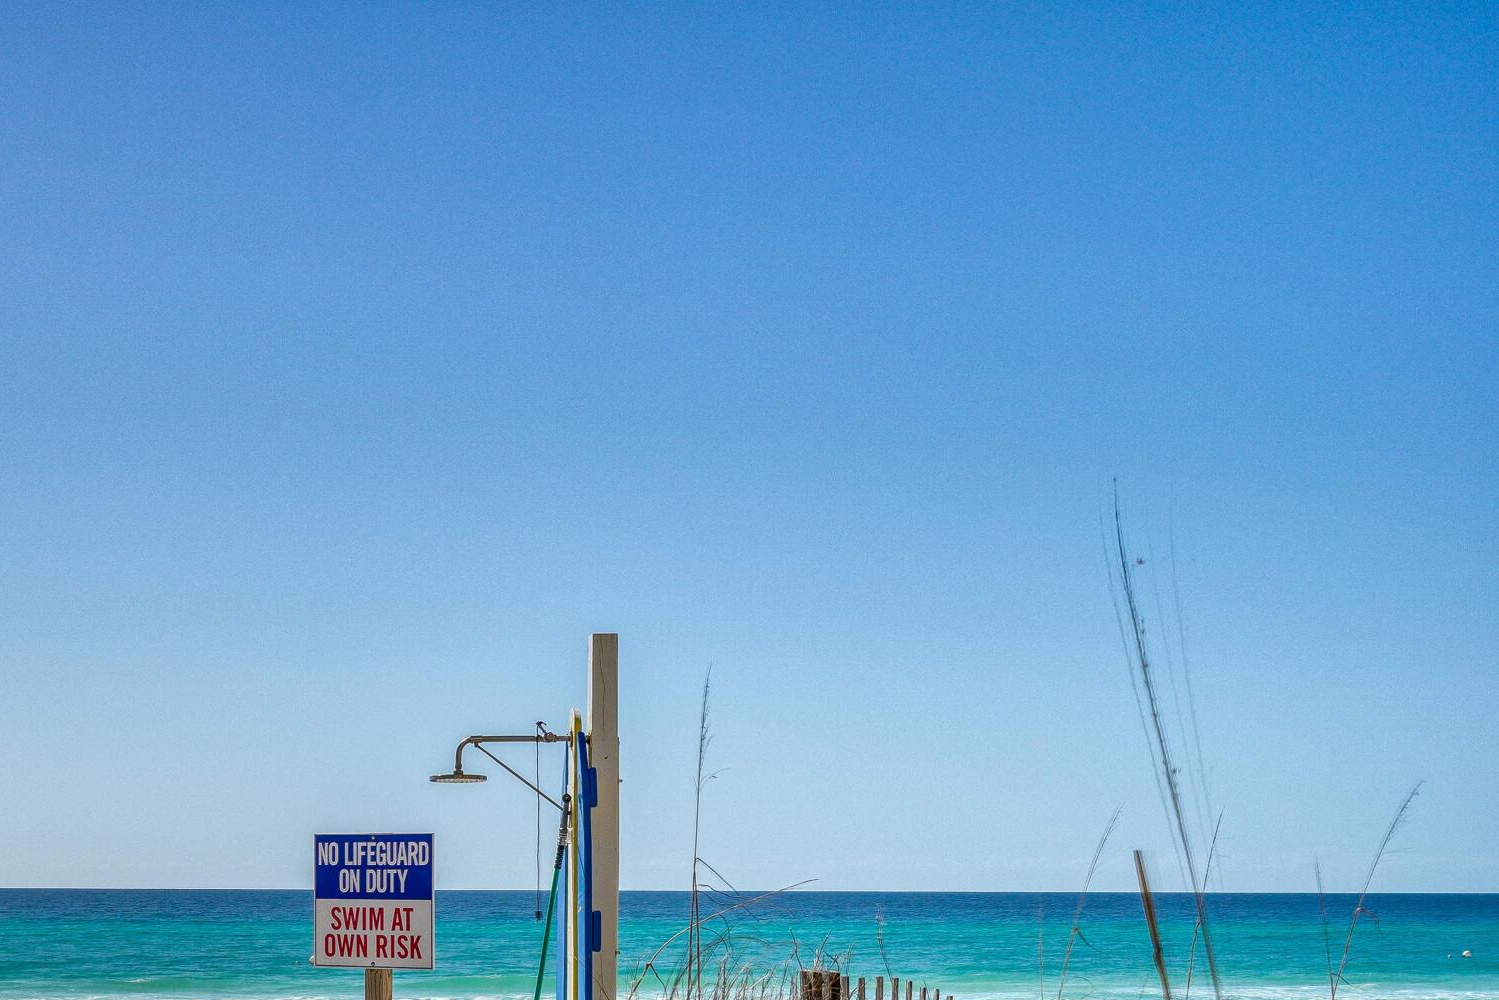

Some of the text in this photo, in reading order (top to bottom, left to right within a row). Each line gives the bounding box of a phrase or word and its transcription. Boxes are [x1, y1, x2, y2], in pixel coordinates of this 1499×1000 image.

[318, 841, 429, 866] NO LIFEGUARD
[339, 869, 408, 893] ON DUTY
[330, 906, 414, 931] SWIM AT
[324, 933, 422, 959] OWN RISK
